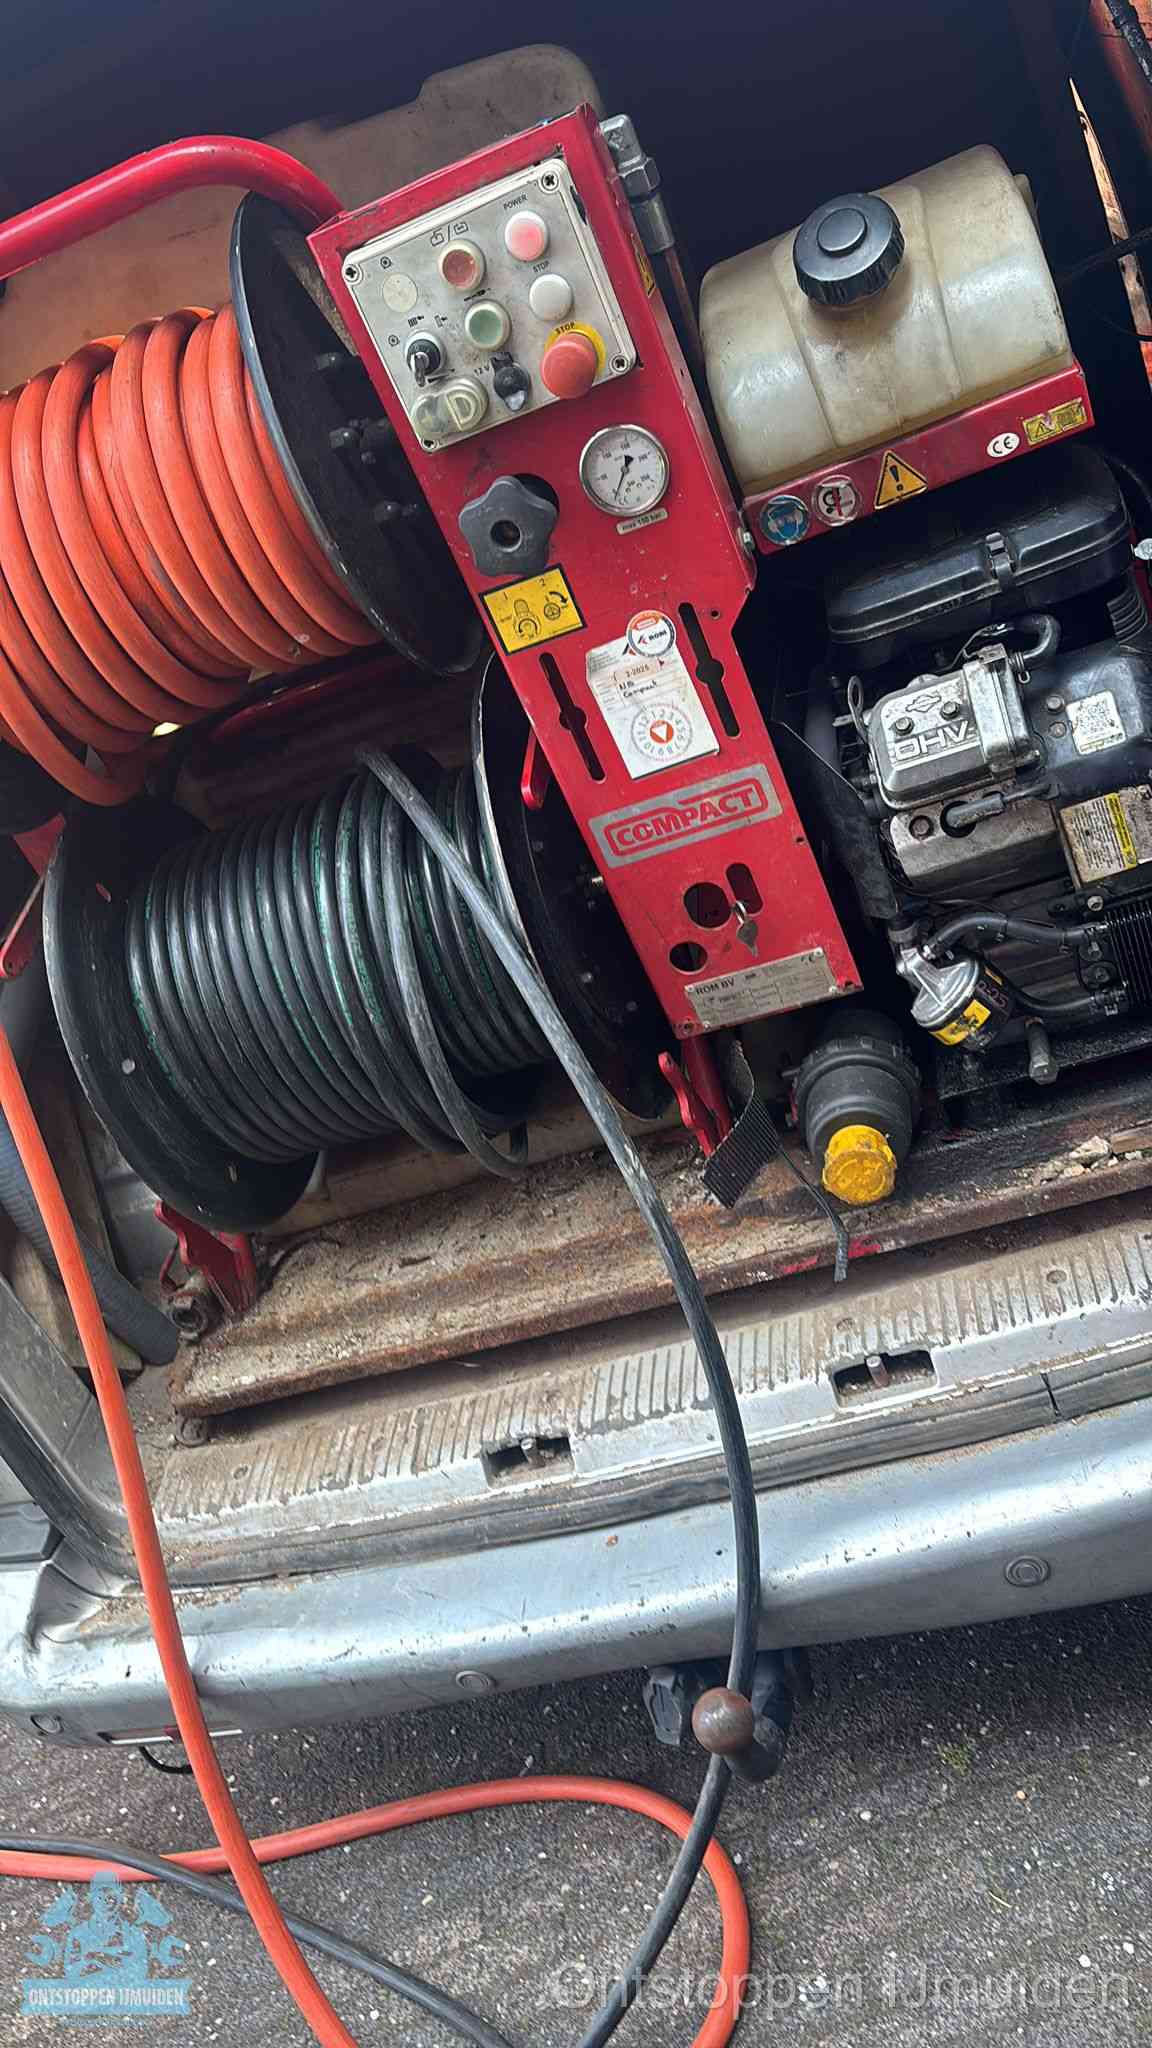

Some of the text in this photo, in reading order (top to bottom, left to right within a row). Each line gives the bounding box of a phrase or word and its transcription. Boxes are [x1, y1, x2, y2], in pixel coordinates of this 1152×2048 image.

[503, 194, 528, 210] POWER
[532, 260, 550, 273] STOP
[555, 321, 576, 335] STOP
[991, 435, 1014, 454] CE
[893, 718, 970, 760] OHV
[616, 787, 755, 846] COMPACT
